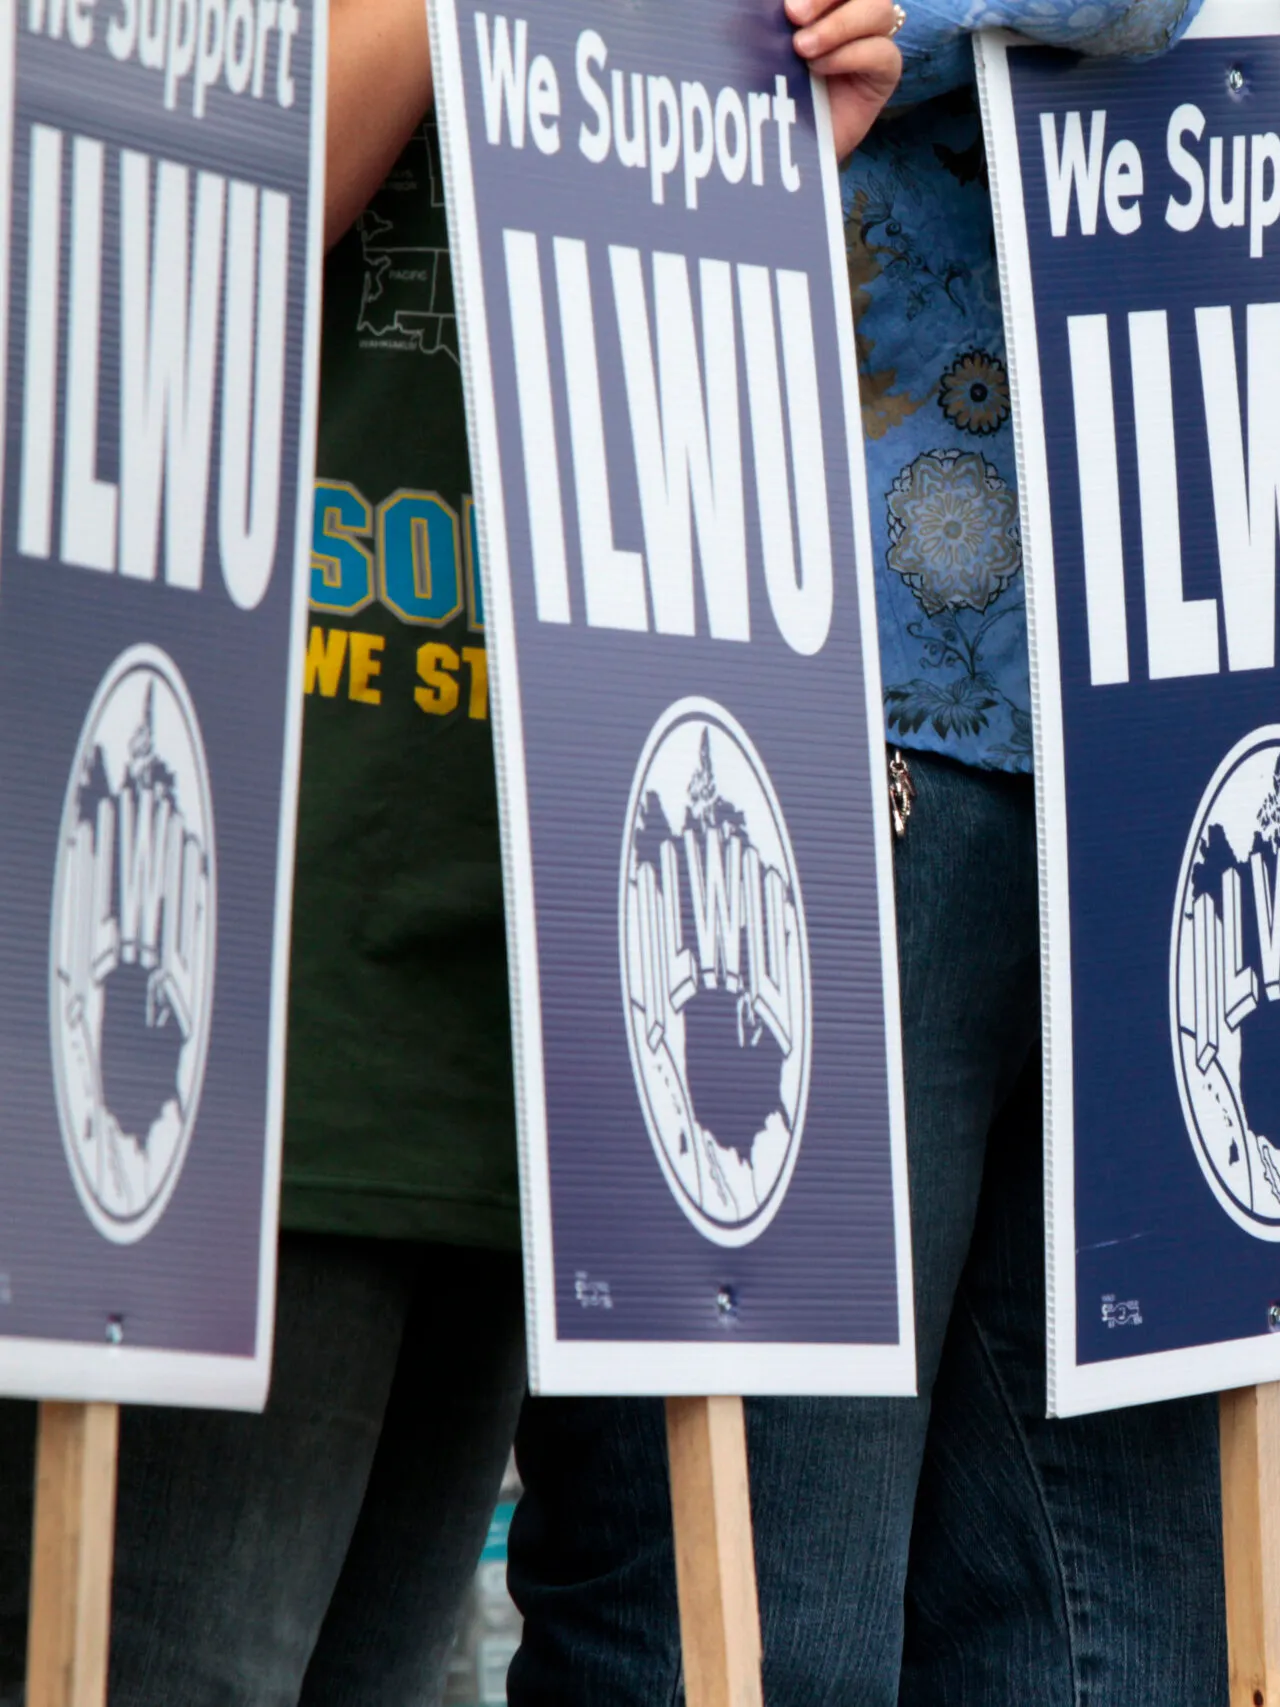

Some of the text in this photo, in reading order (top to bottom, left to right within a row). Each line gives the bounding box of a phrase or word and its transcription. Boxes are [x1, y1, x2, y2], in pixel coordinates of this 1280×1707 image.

[474, 11, 801, 210] We Support
[1040, 110, 1143, 237] We
[18, 123, 290, 611] ILWU
[503, 228, 834, 656] ILWU
[304, 625, 385, 705] WE
